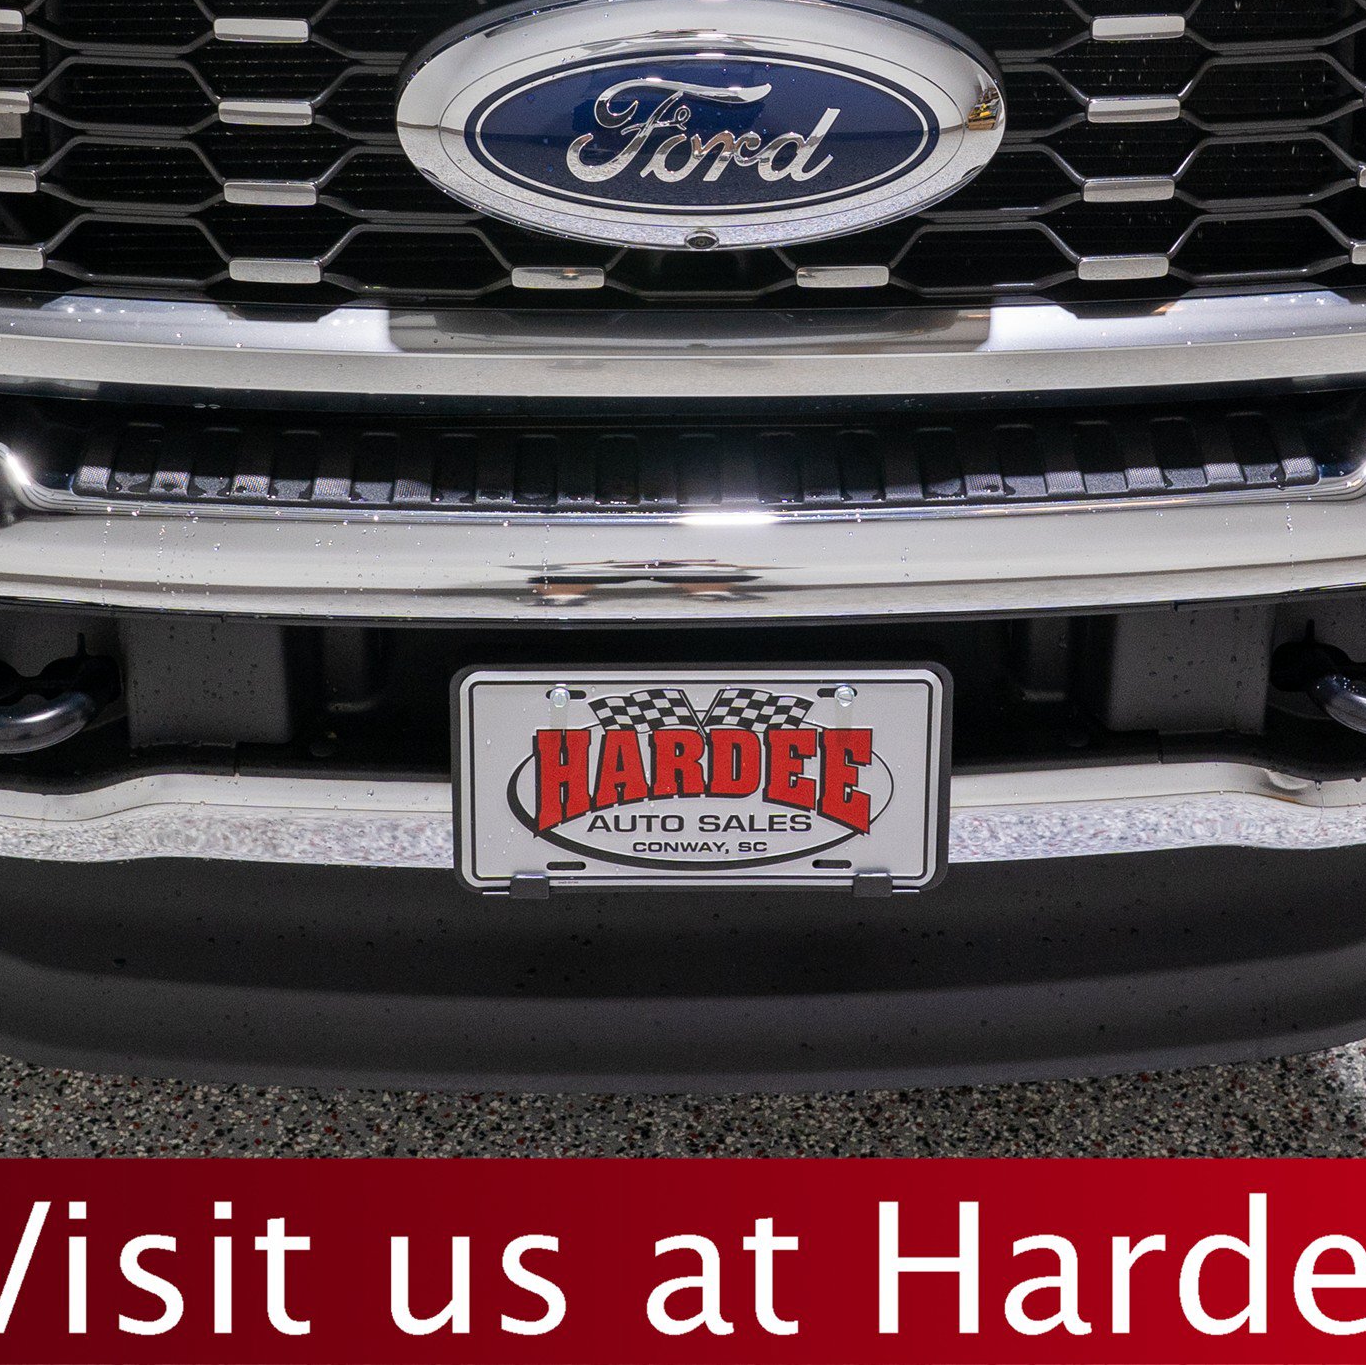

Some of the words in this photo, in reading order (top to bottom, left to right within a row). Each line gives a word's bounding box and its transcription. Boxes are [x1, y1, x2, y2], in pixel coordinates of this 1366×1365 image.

[566, 78, 841, 183] Ford
[532, 727, 874, 838] HARDEE
[587, 813, 686, 833] AUTO
[698, 812, 813, 833] SALES
[631, 841, 730, 855] CONWAY,
[737, 840, 768, 853] SC
